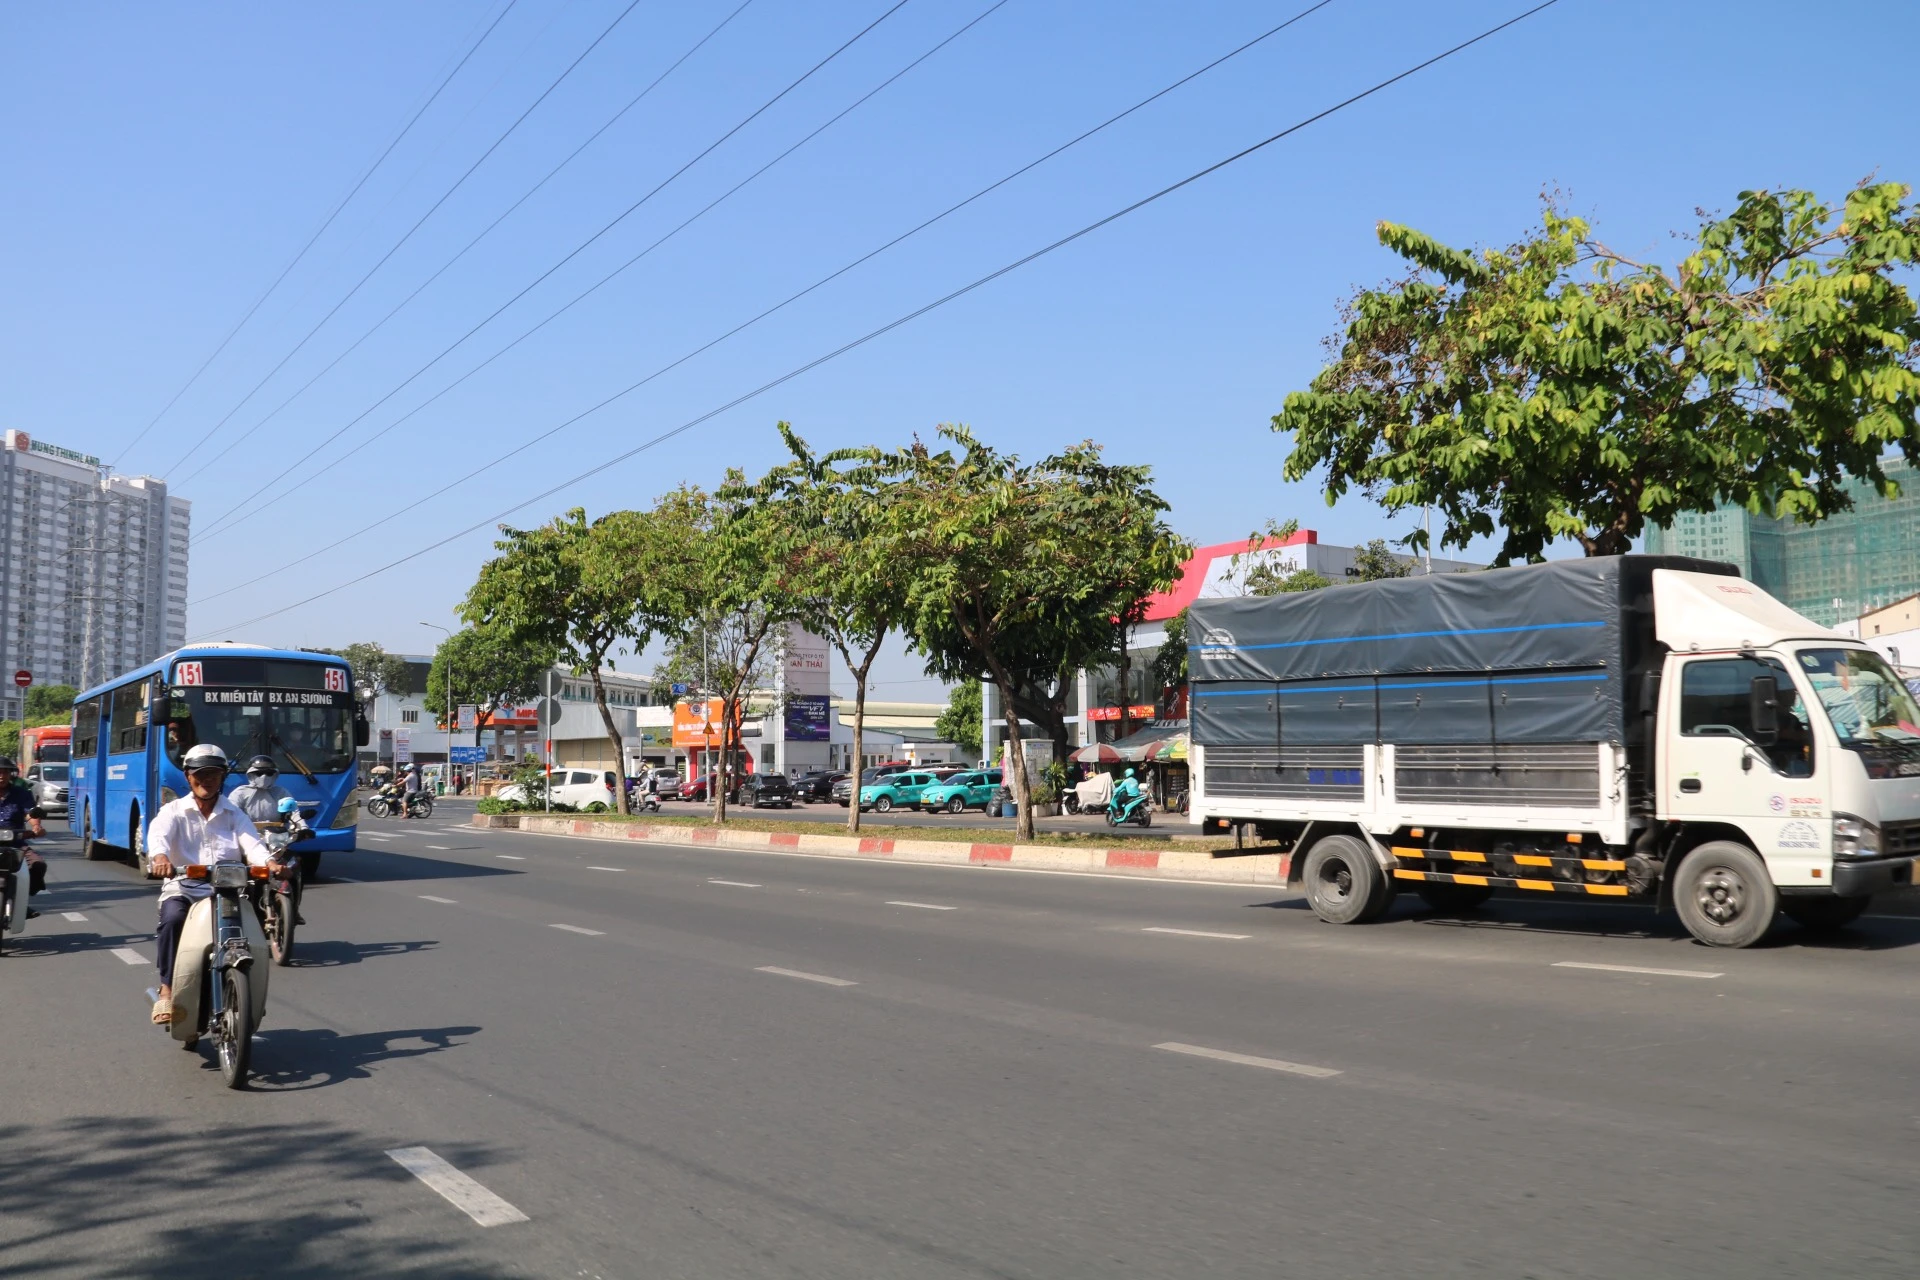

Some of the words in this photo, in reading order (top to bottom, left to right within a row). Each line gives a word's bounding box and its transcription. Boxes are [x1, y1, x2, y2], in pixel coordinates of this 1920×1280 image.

[178, 664, 201, 685] 151
[325, 669, 345, 690] 151
[205, 691, 219, 703] BX
[247, 690, 264, 703] TÂY
[269, 692, 283, 703] BX
[285, 693, 299, 703] AN
